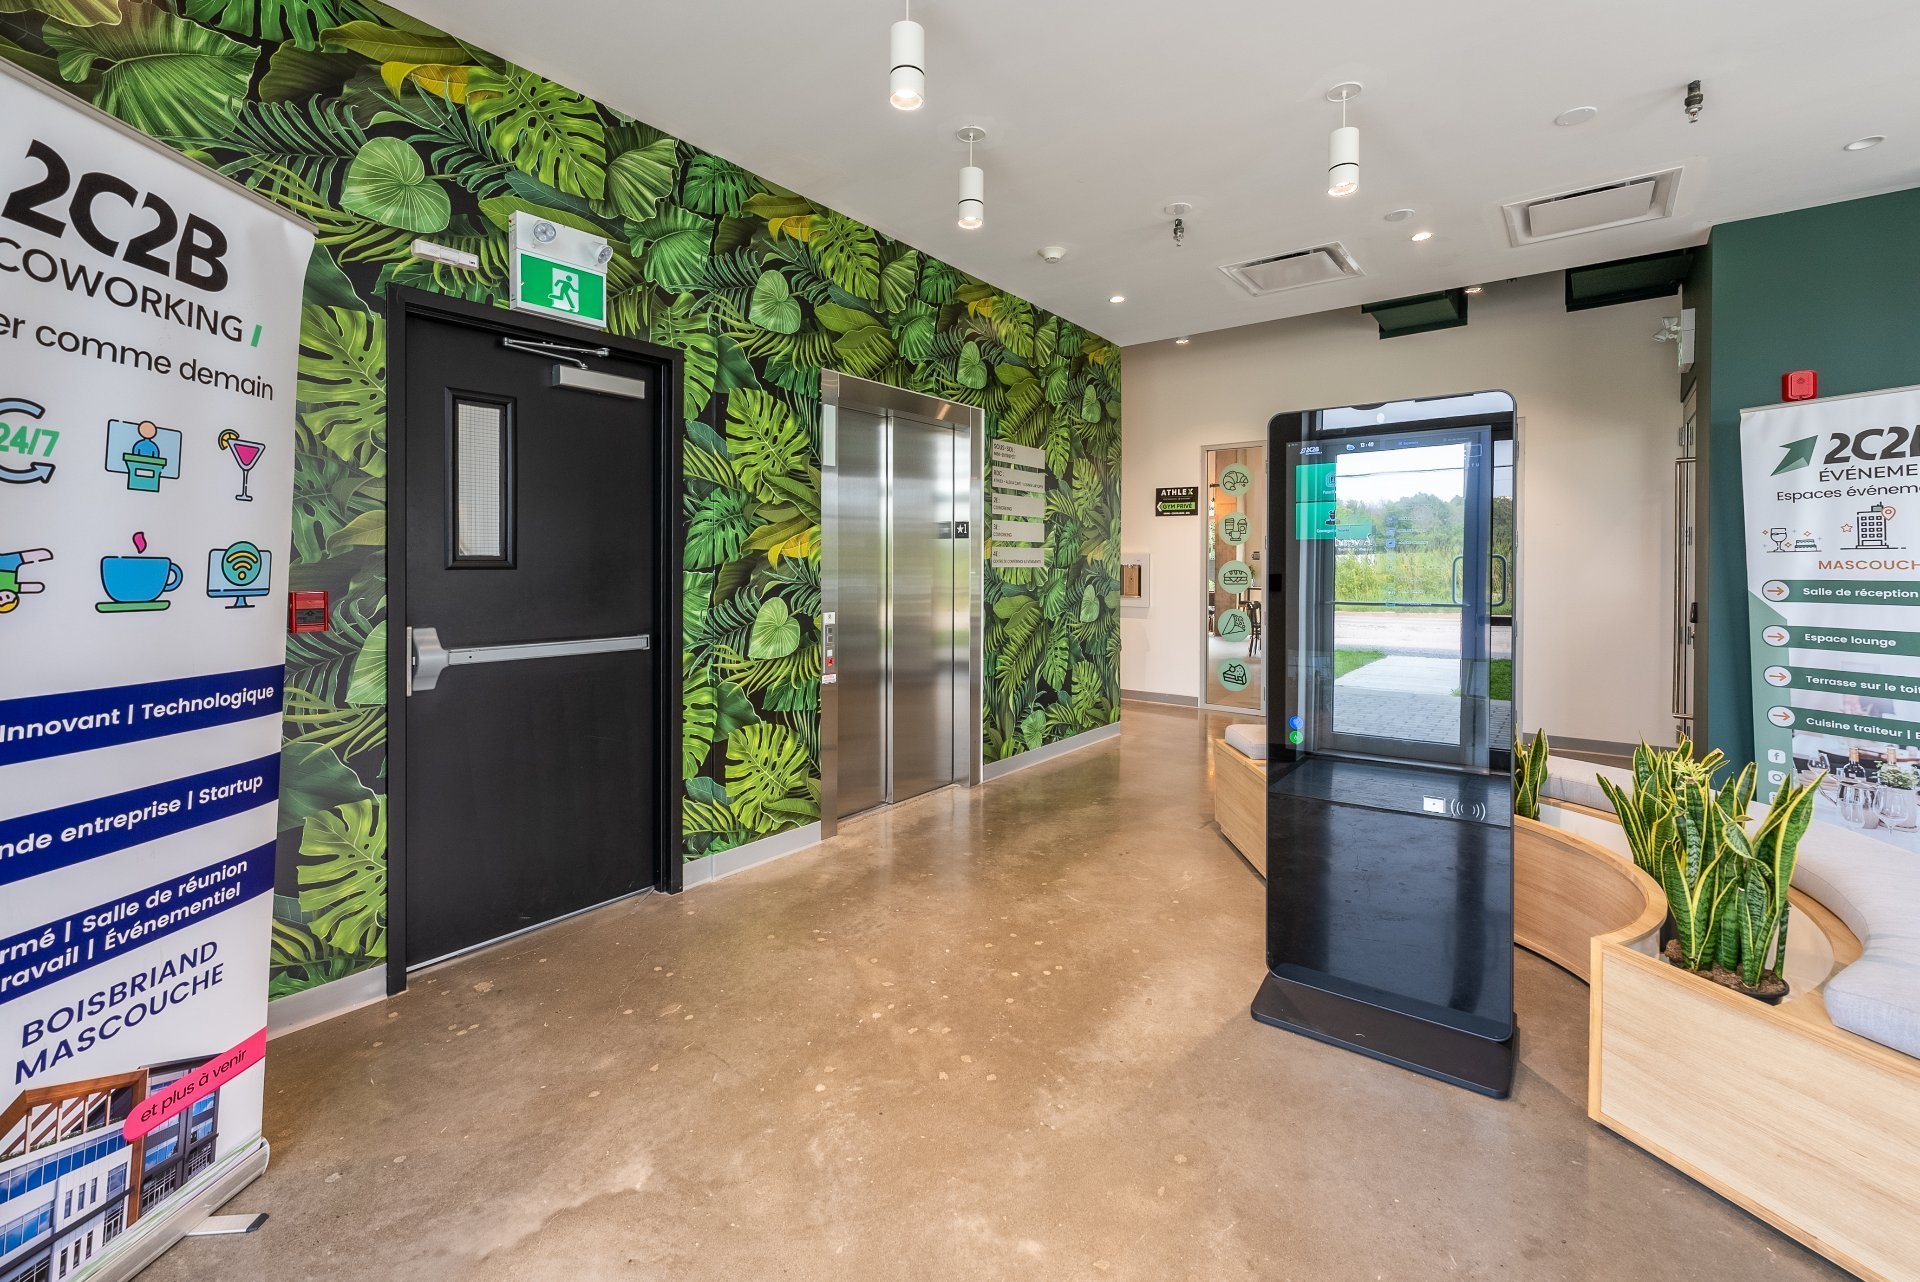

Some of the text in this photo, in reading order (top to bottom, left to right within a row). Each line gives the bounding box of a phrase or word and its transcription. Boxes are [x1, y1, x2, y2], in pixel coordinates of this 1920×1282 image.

[1, 139, 228, 292] 2C2B
[36, 325, 171, 374] comme
[180, 358, 273, 400] demain
[1161, 488, 1194, 496] ATHLEX
[1777, 485, 1920, 503] Espaces événem
[1819, 463, 1918, 482] ÉVÉNEME
[1803, 587, 1919, 599] Salle de réception
[1804, 633, 1897, 648] Espace lounge
[0, 708, 120, 743] Innovant
[142, 685, 274, 720] Technologique
[1806, 675, 1857, 689] Terrasse
[1860, 682, 1881, 691] sur
[1884, 681, 1896, 692] le
[1806, 717, 1850, 731] Cuisine
[1853, 722, 1903, 737] traiteur
[61, 798, 181, 843] entreprise
[199, 775, 263, 804] Startup
[83, 893, 140, 933] Salle
[146, 886, 172, 909] de
[178, 859, 248, 897] réunion
[105, 881, 241, 951] Événementiel
[15, 962, 224, 1084] MASCOUCHE
[21, 941, 219, 1049] BOISBRIAND
[140, 1048, 247, 1123] et plus à venir
